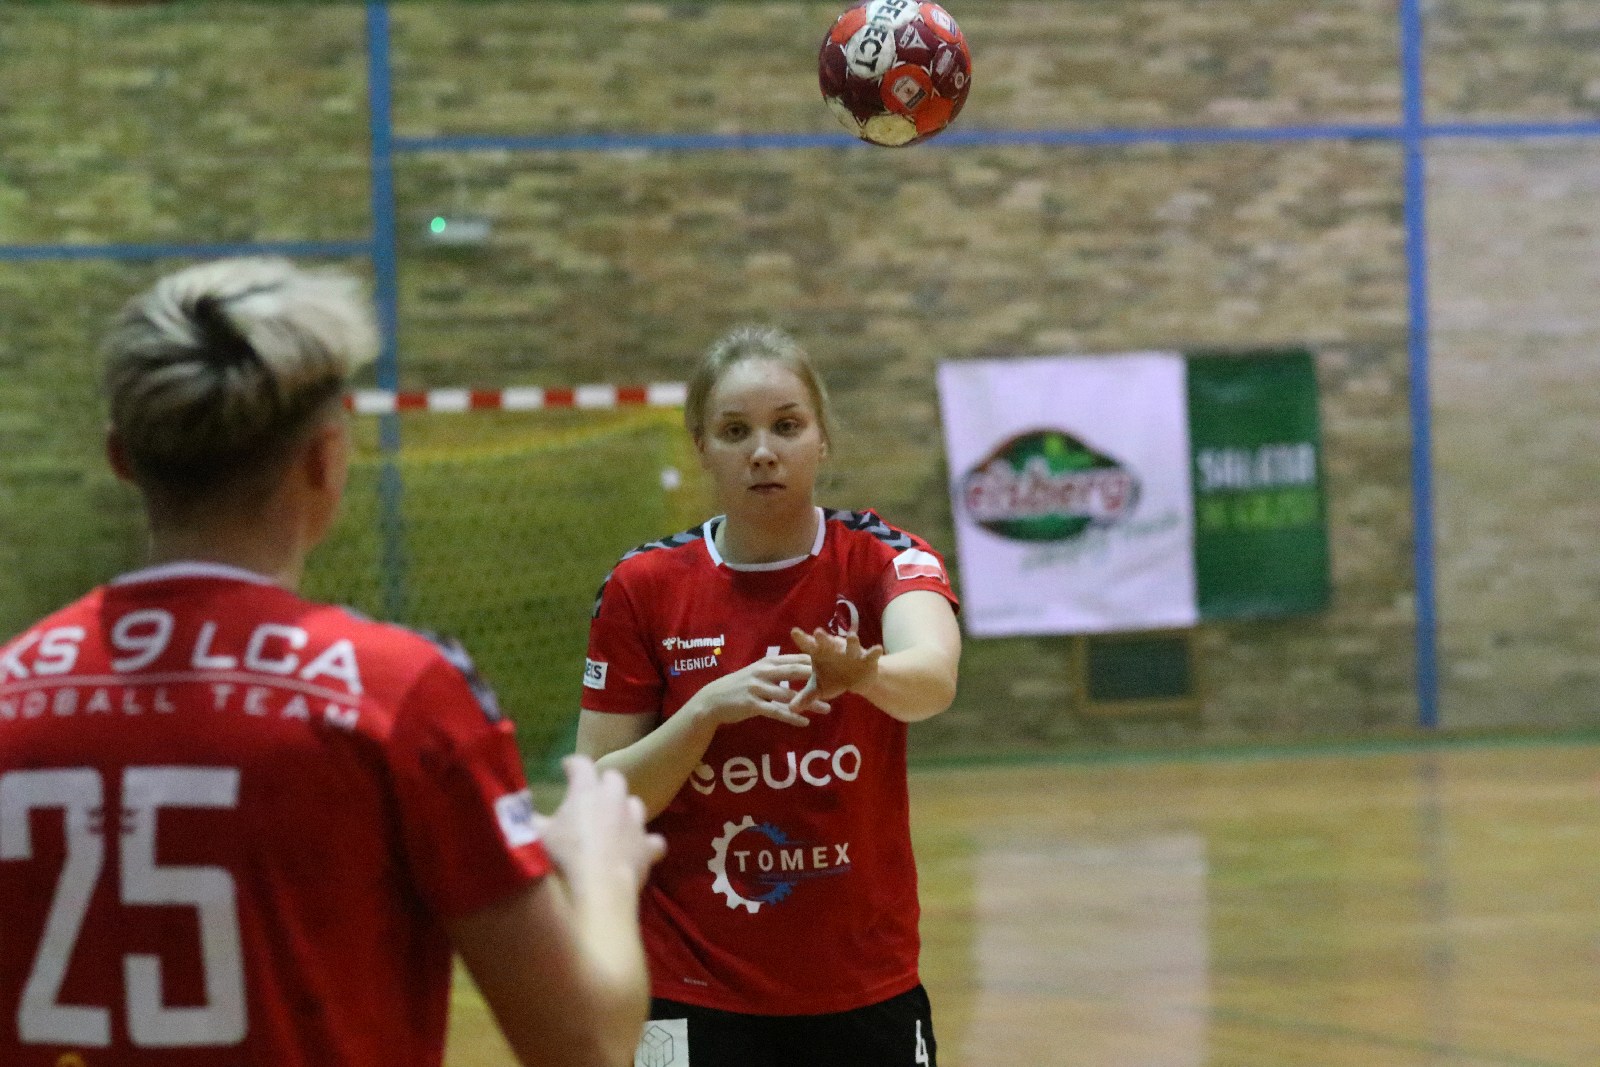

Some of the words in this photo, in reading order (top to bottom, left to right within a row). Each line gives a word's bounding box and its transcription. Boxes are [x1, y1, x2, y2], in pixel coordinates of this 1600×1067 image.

[855, 0, 909, 72] SELECT
[111, 608, 174, 673] 9
[191, 620, 364, 696] LCA
[674, 654, 718, 671] LEGNICA
[677, 633, 725, 650] hummel
[211, 682, 359, 731] TEAM
[733, 842, 851, 873] TOMEX
[0, 765, 248, 1047] 25
[915, 1019, 929, 1067] 4
